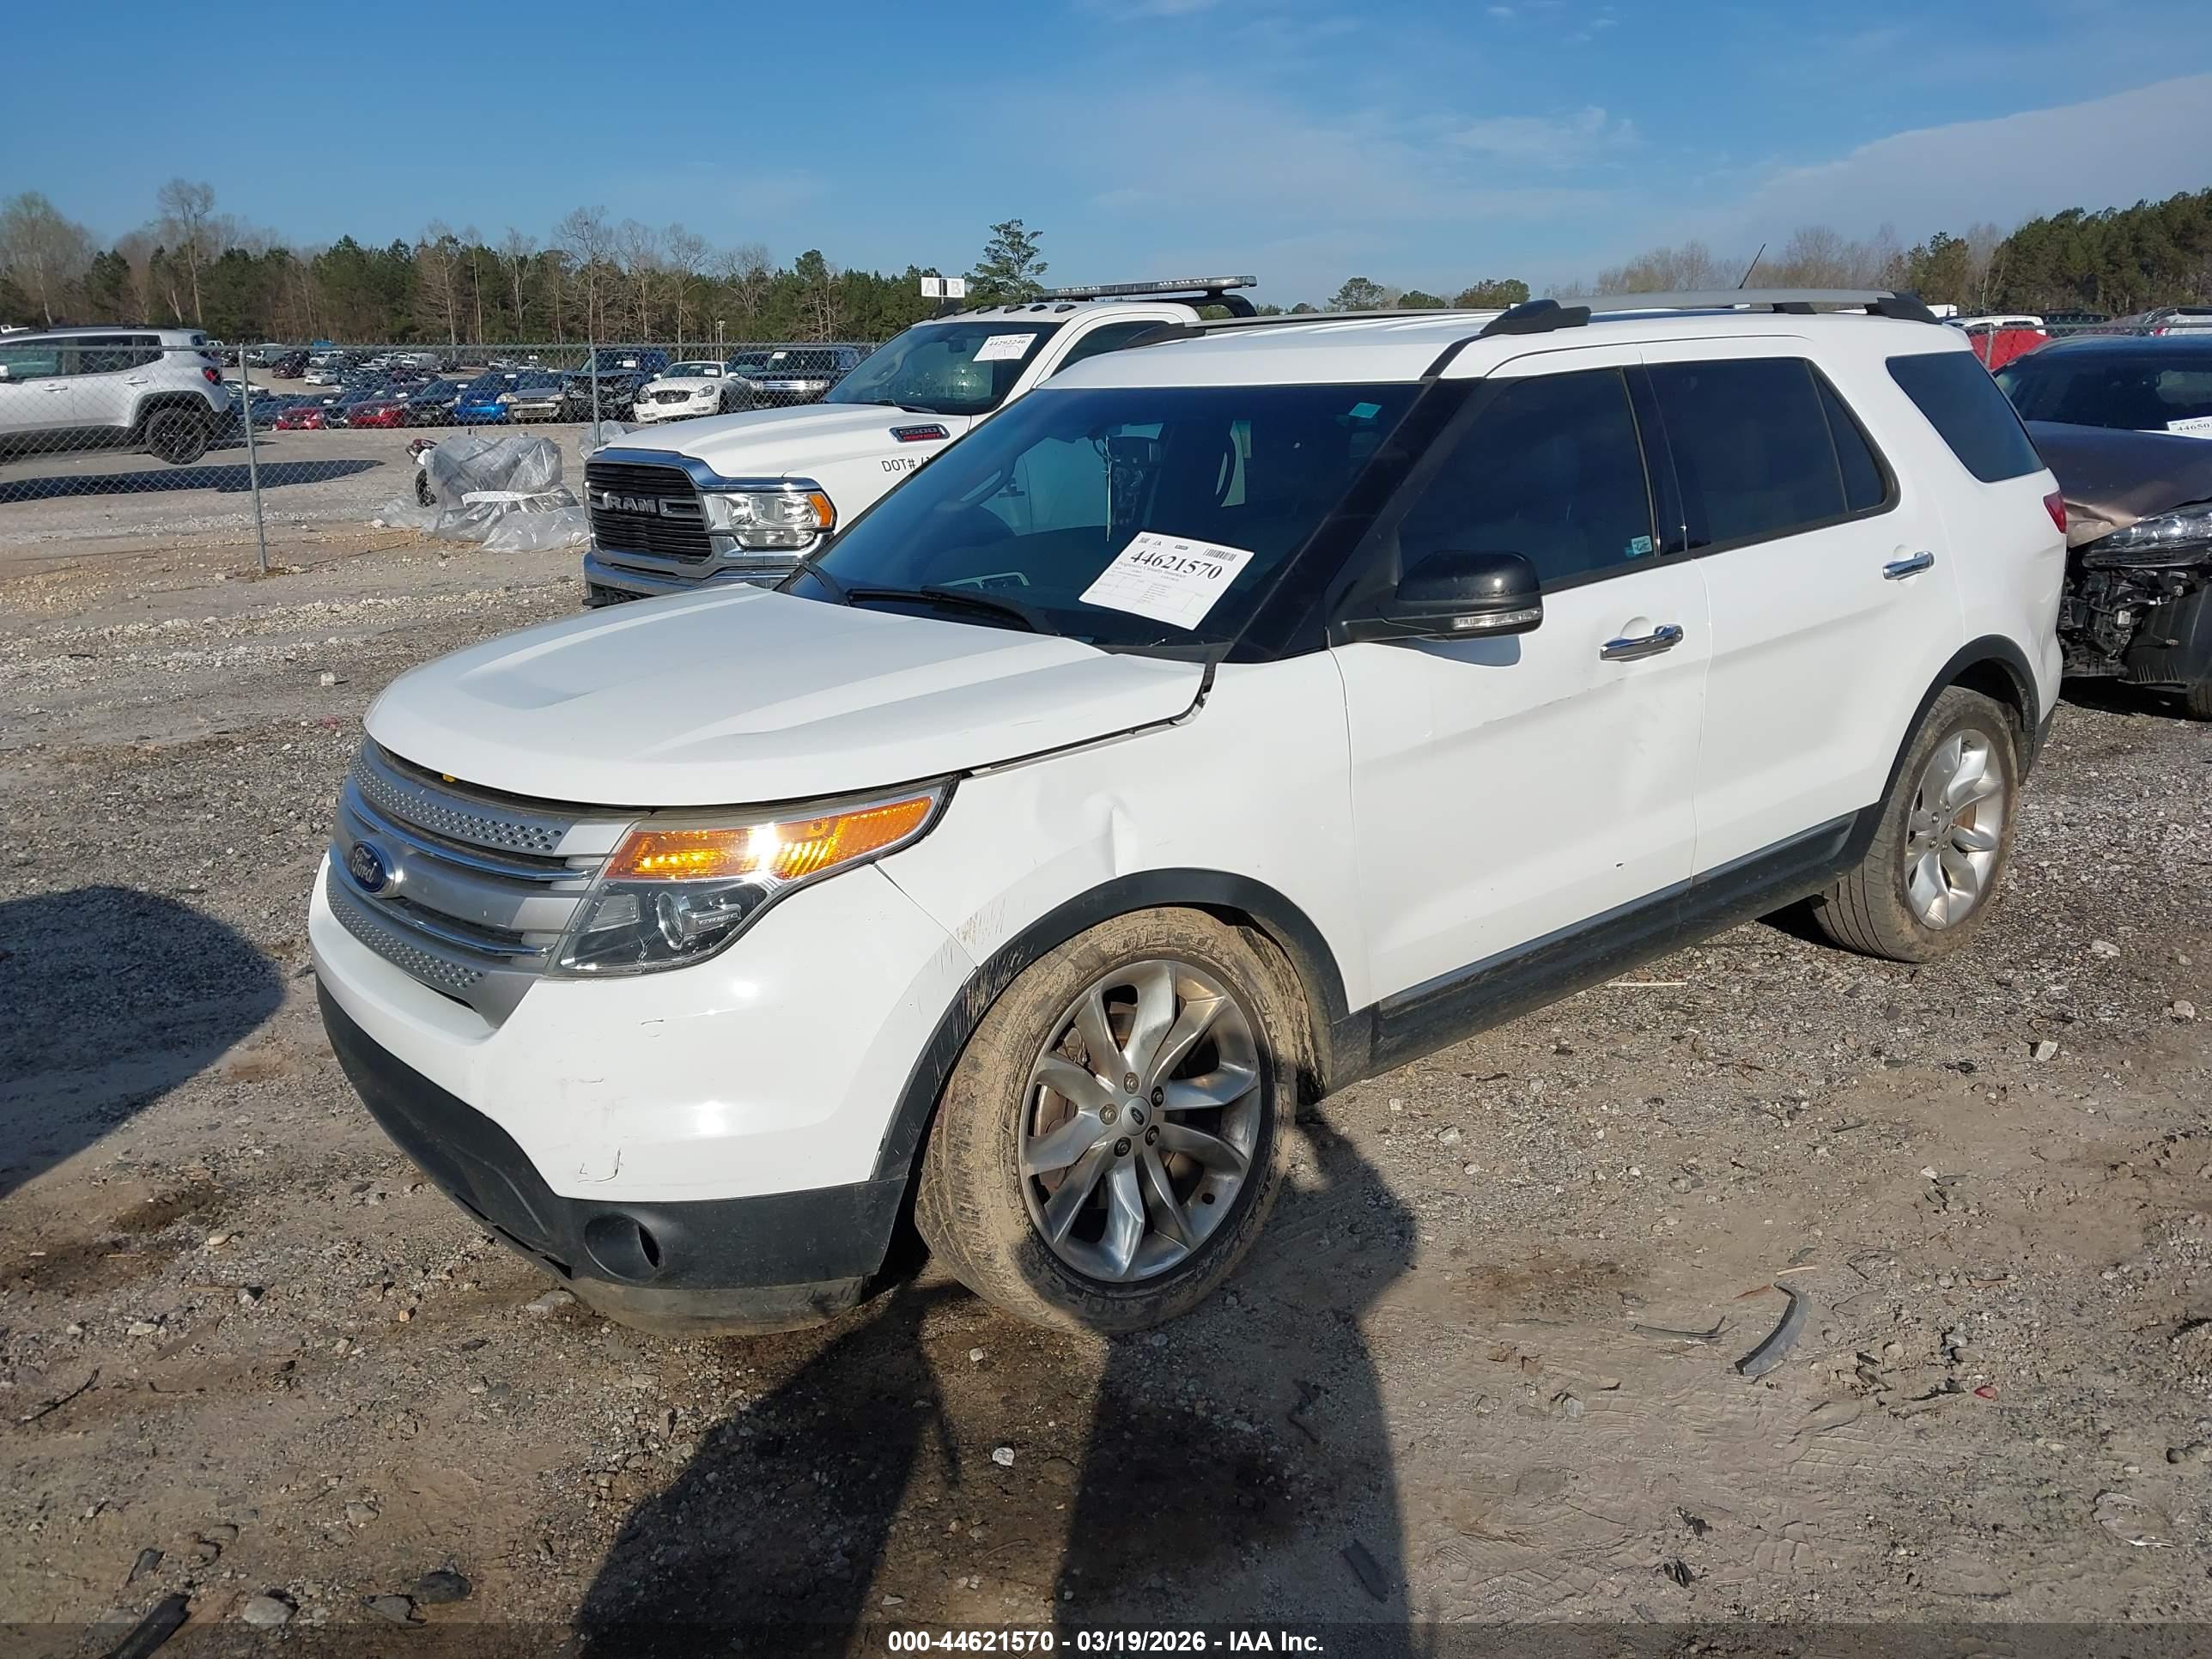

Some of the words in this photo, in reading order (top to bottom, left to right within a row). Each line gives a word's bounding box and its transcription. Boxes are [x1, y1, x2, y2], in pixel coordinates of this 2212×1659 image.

[925, 280, 938, 295] A
[951, 281, 961, 295] B
[881, 458, 916, 472] DOT#
[608, 495, 657, 514] RAM
[1130, 550, 1223, 580] 44621570
[351, 847, 378, 884] Ford
